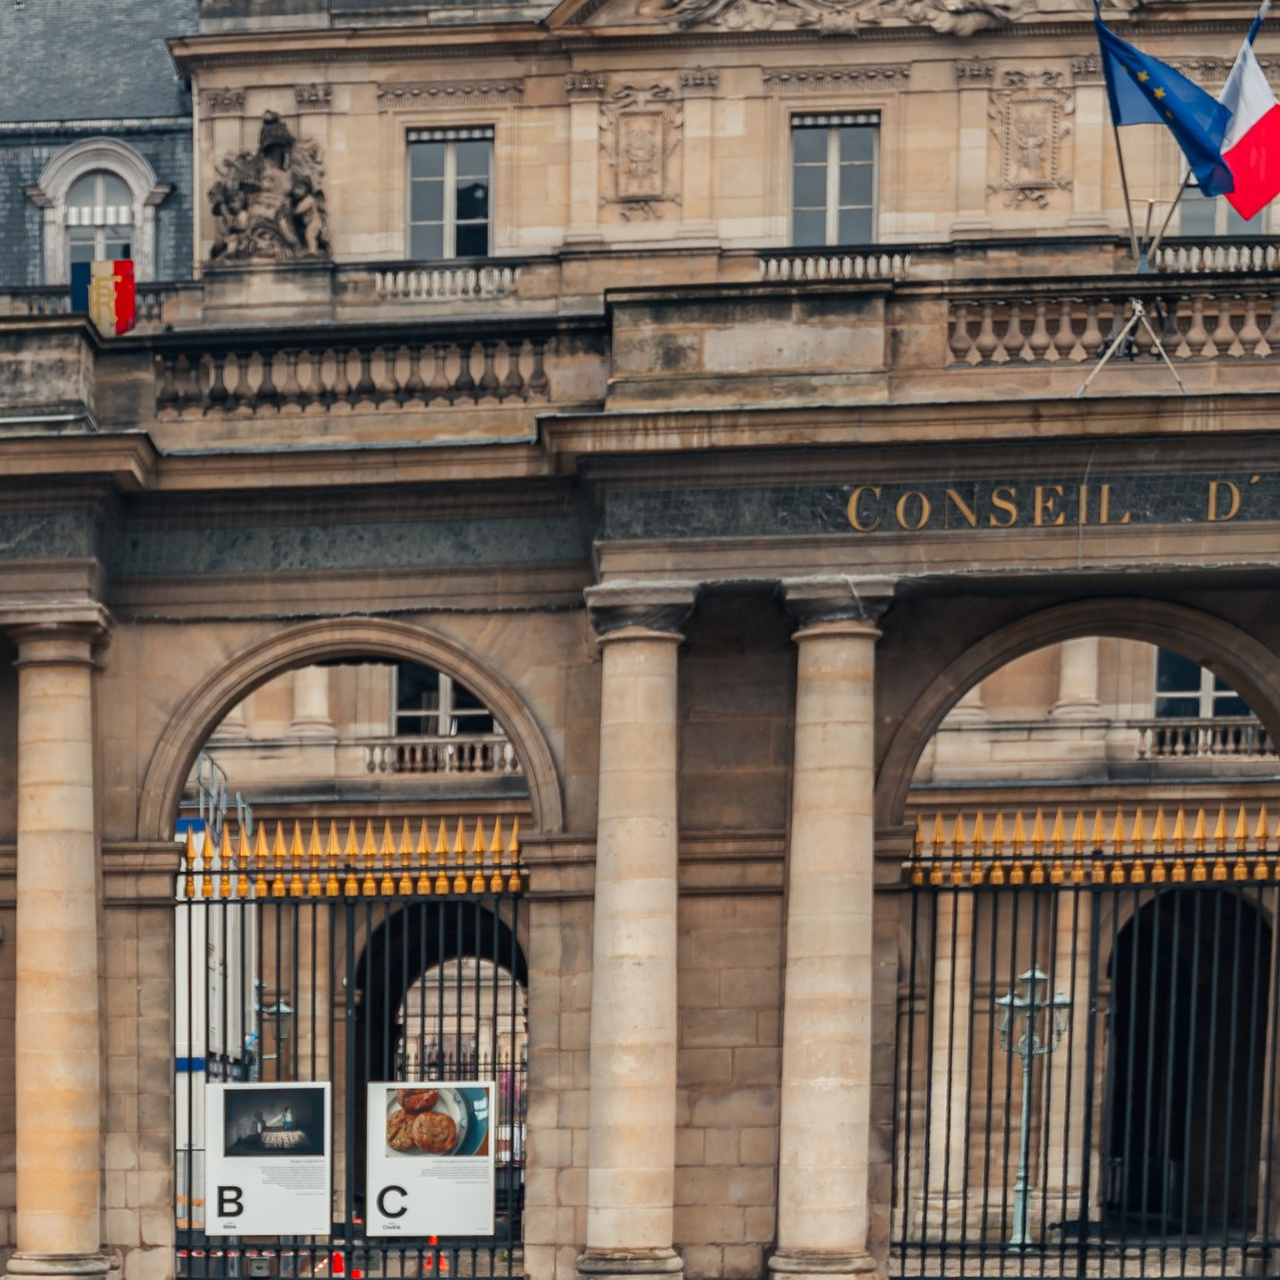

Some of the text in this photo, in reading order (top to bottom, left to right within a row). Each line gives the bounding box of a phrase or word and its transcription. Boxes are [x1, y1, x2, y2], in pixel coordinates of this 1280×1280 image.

[845, 483, 1131, 533] CONSEIL
[217, 1185, 244, 1218] B
[376, 1184, 408, 1219] C
